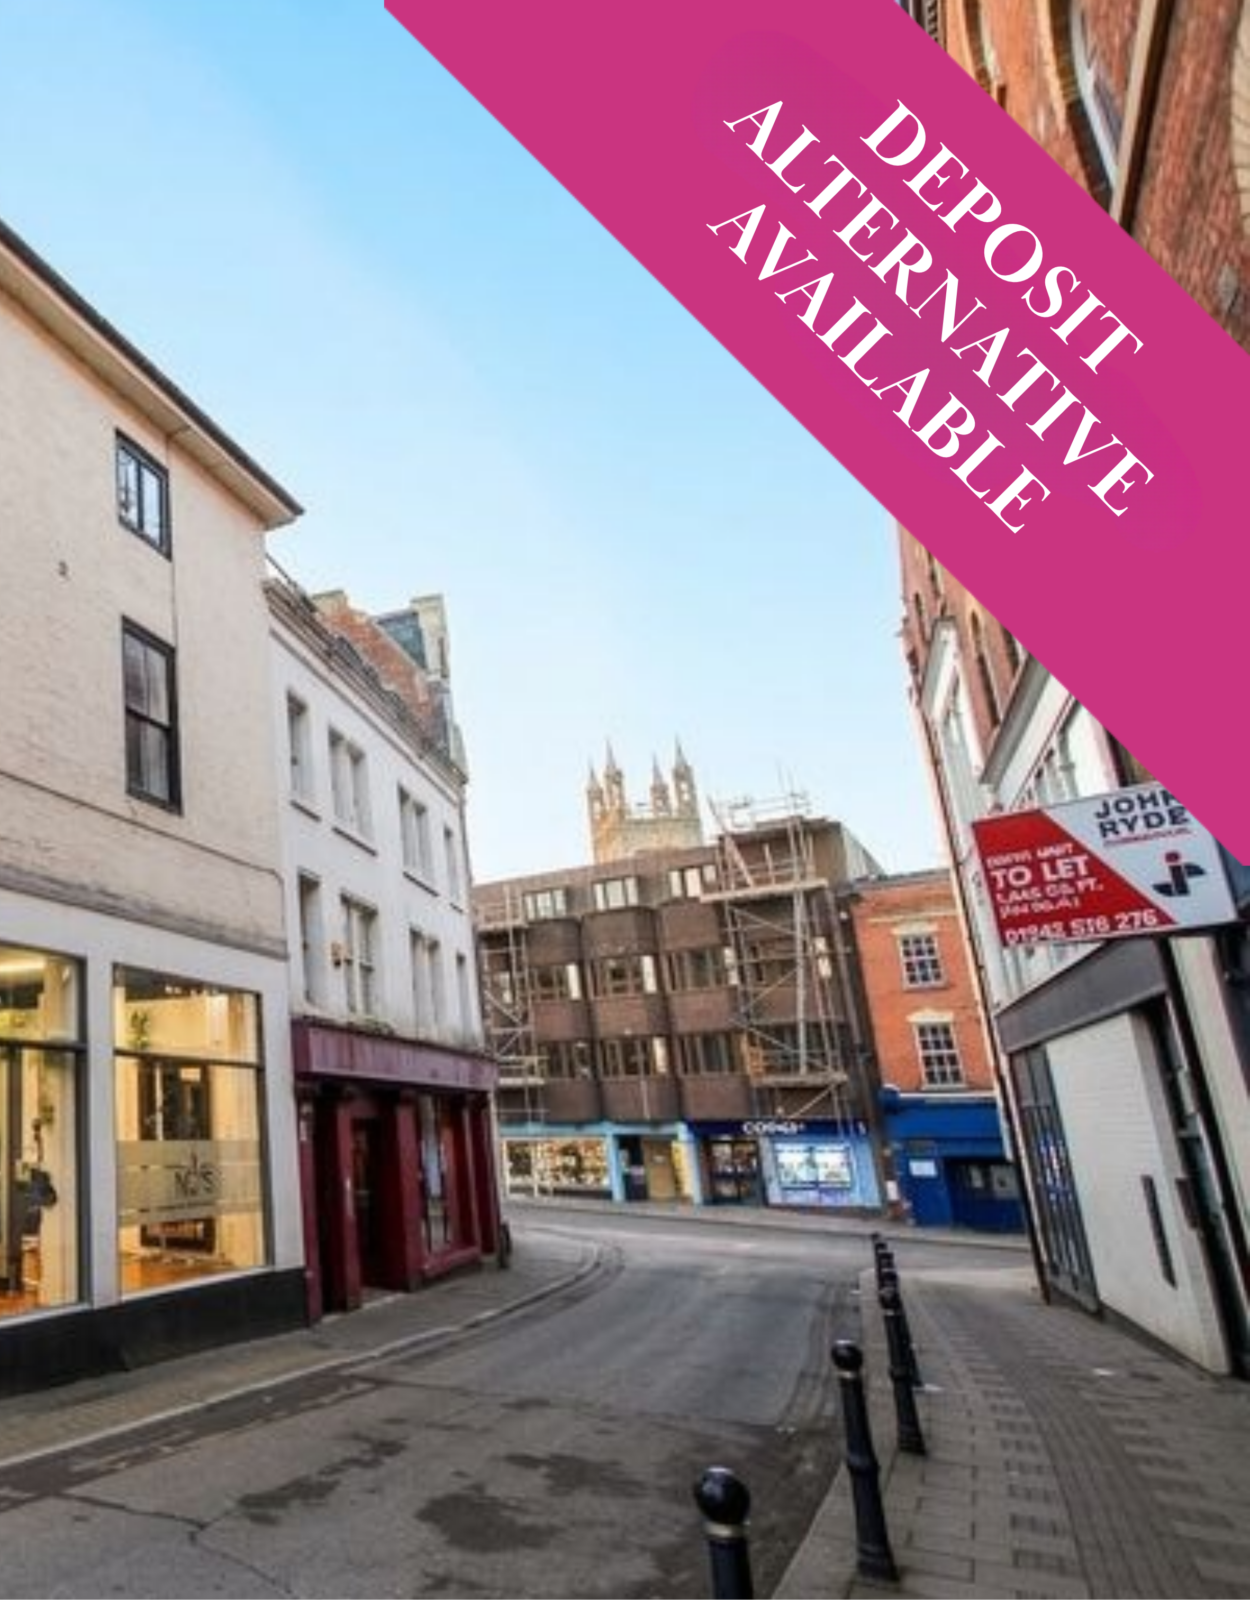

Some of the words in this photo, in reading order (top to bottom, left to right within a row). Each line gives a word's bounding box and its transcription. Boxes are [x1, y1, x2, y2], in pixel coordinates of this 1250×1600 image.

[1099, 805, 1190, 838] RYDE
[990, 865, 1032, 889] TO
[1040, 854, 1089, 881] LET
[1114, 908, 1158, 931] 276
